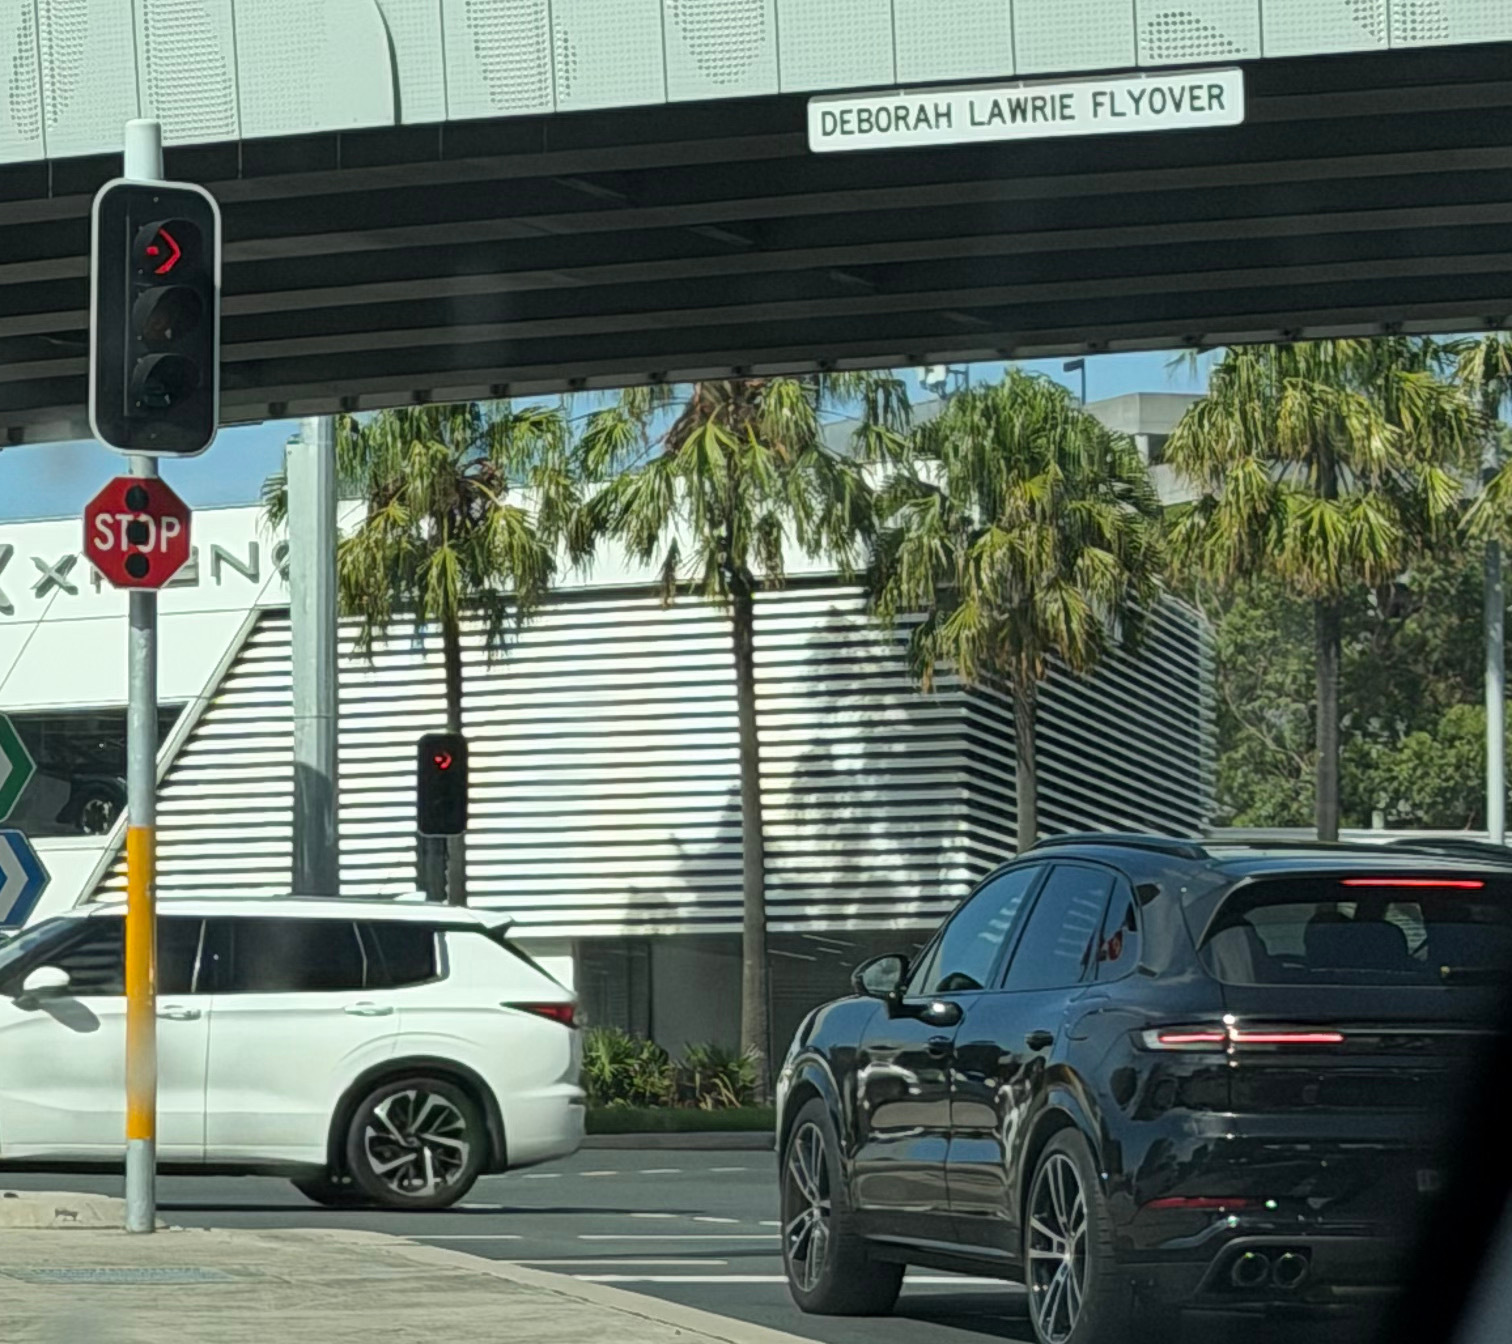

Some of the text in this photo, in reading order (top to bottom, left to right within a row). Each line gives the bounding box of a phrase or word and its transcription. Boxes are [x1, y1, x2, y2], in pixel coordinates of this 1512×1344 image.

[821, 83, 1226, 137] DEBORAH LAWRIE FLYOVER
[93, 512, 181, 554] STOP
